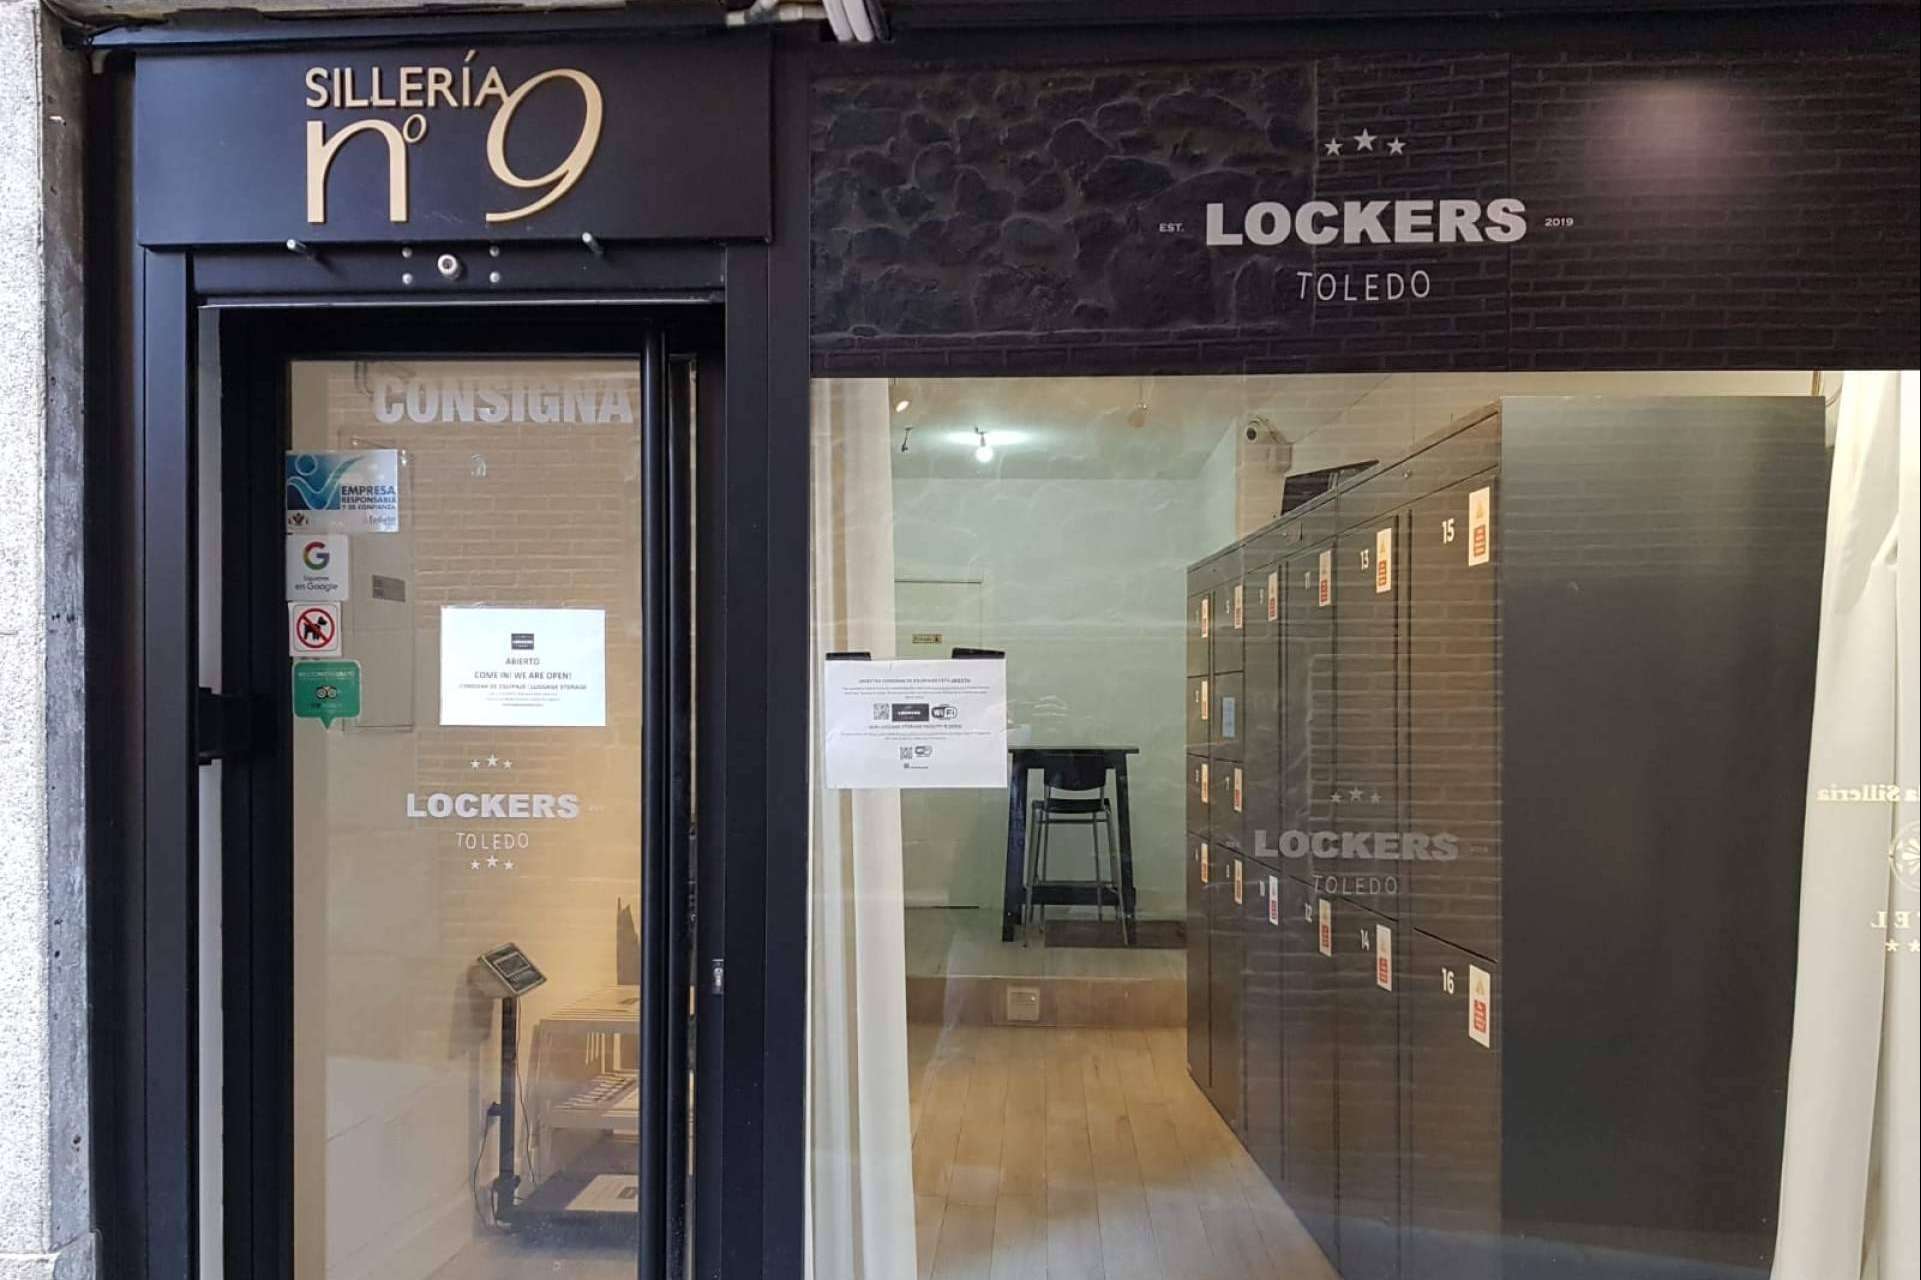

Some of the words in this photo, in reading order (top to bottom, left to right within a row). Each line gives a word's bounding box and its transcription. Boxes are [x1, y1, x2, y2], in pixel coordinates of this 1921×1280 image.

[305, 50, 510, 108] SILLERÍA
[485, 68, 603, 222] 9
[1159, 222, 1185, 232] EST.
[1206, 199, 1527, 246] LOCKERS
[1545, 217, 1574, 228] 2019
[1296, 270, 1430, 301] TOLEDO
[374, 377, 634, 424] CONSIGNA
[342, 485, 396, 495] EMPRESA
[1442, 518, 1455, 544] 15
[1360, 549, 1369, 570] 13
[307, 582, 338, 592] Google
[529, 671, 544, 680] ARE
[406, 792, 580, 818] LOCKERS
[456, 832, 528, 850] TOLEDO
[1254, 829, 1458, 861] LOCKERS
[1312, 873, 1397, 895] TOLEDO
[1442, 967, 1455, 995] 16
